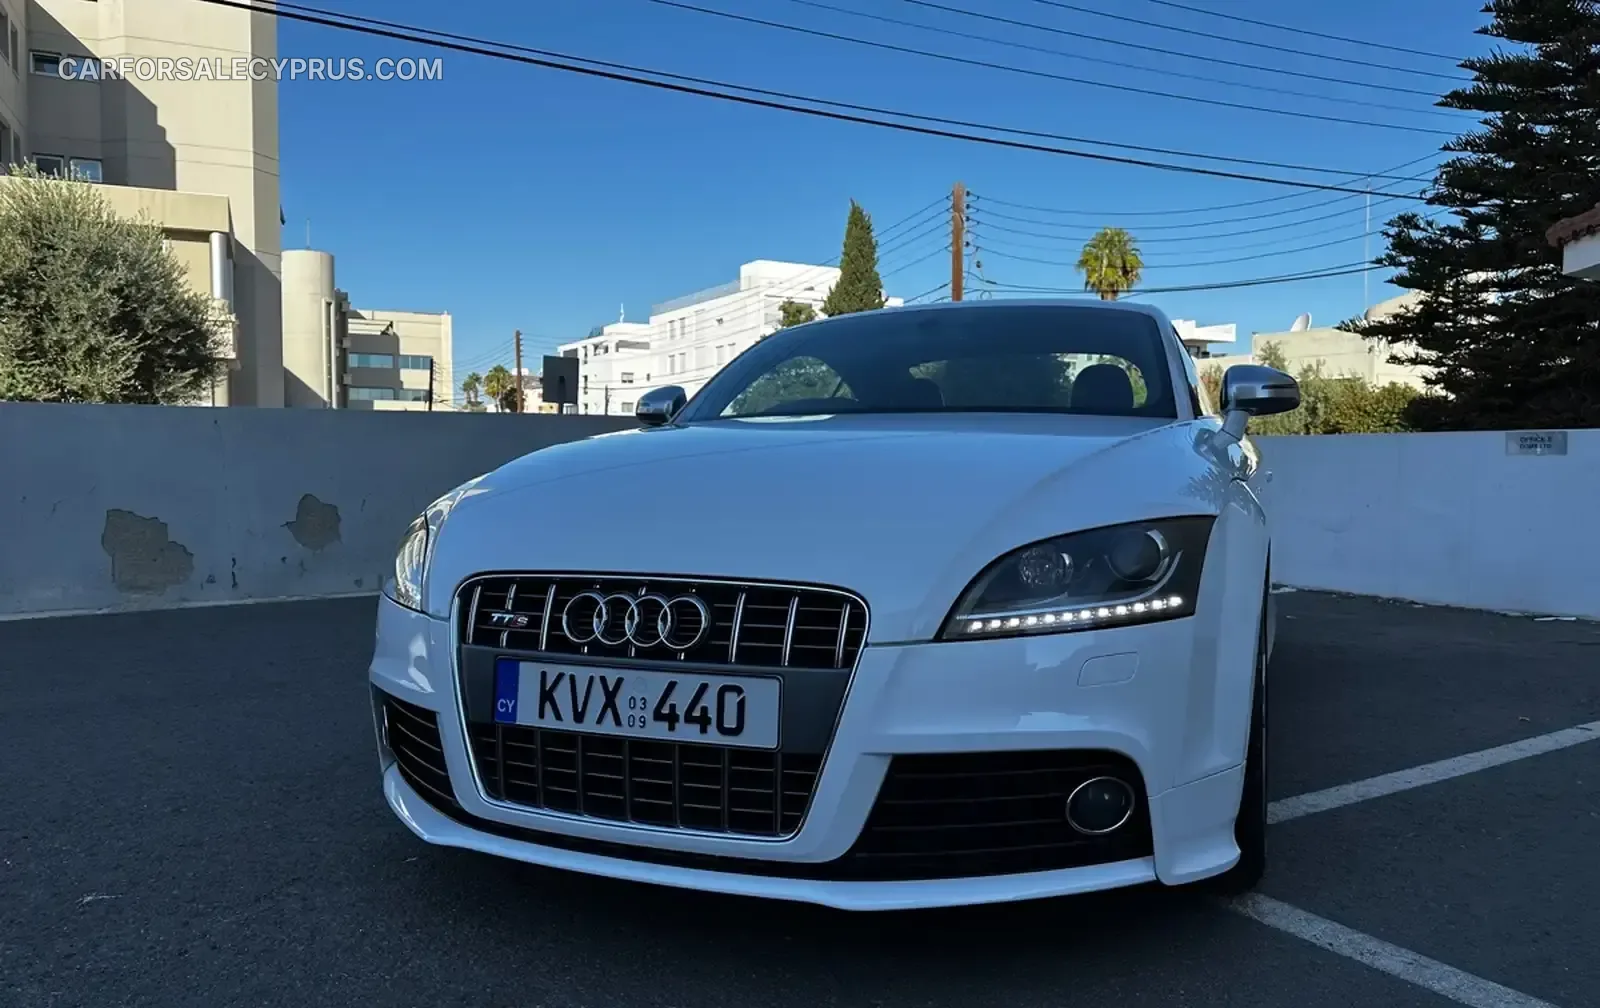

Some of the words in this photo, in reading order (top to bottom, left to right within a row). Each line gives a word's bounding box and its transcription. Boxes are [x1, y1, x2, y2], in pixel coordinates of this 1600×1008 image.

[491, 613, 529, 627] TTS
[497, 699, 514, 713] CY
[538, 670, 624, 727] KVX
[653, 680, 746, 736] 440
[628, 696, 647, 710] 03
[627, 714, 646, 728] 09
